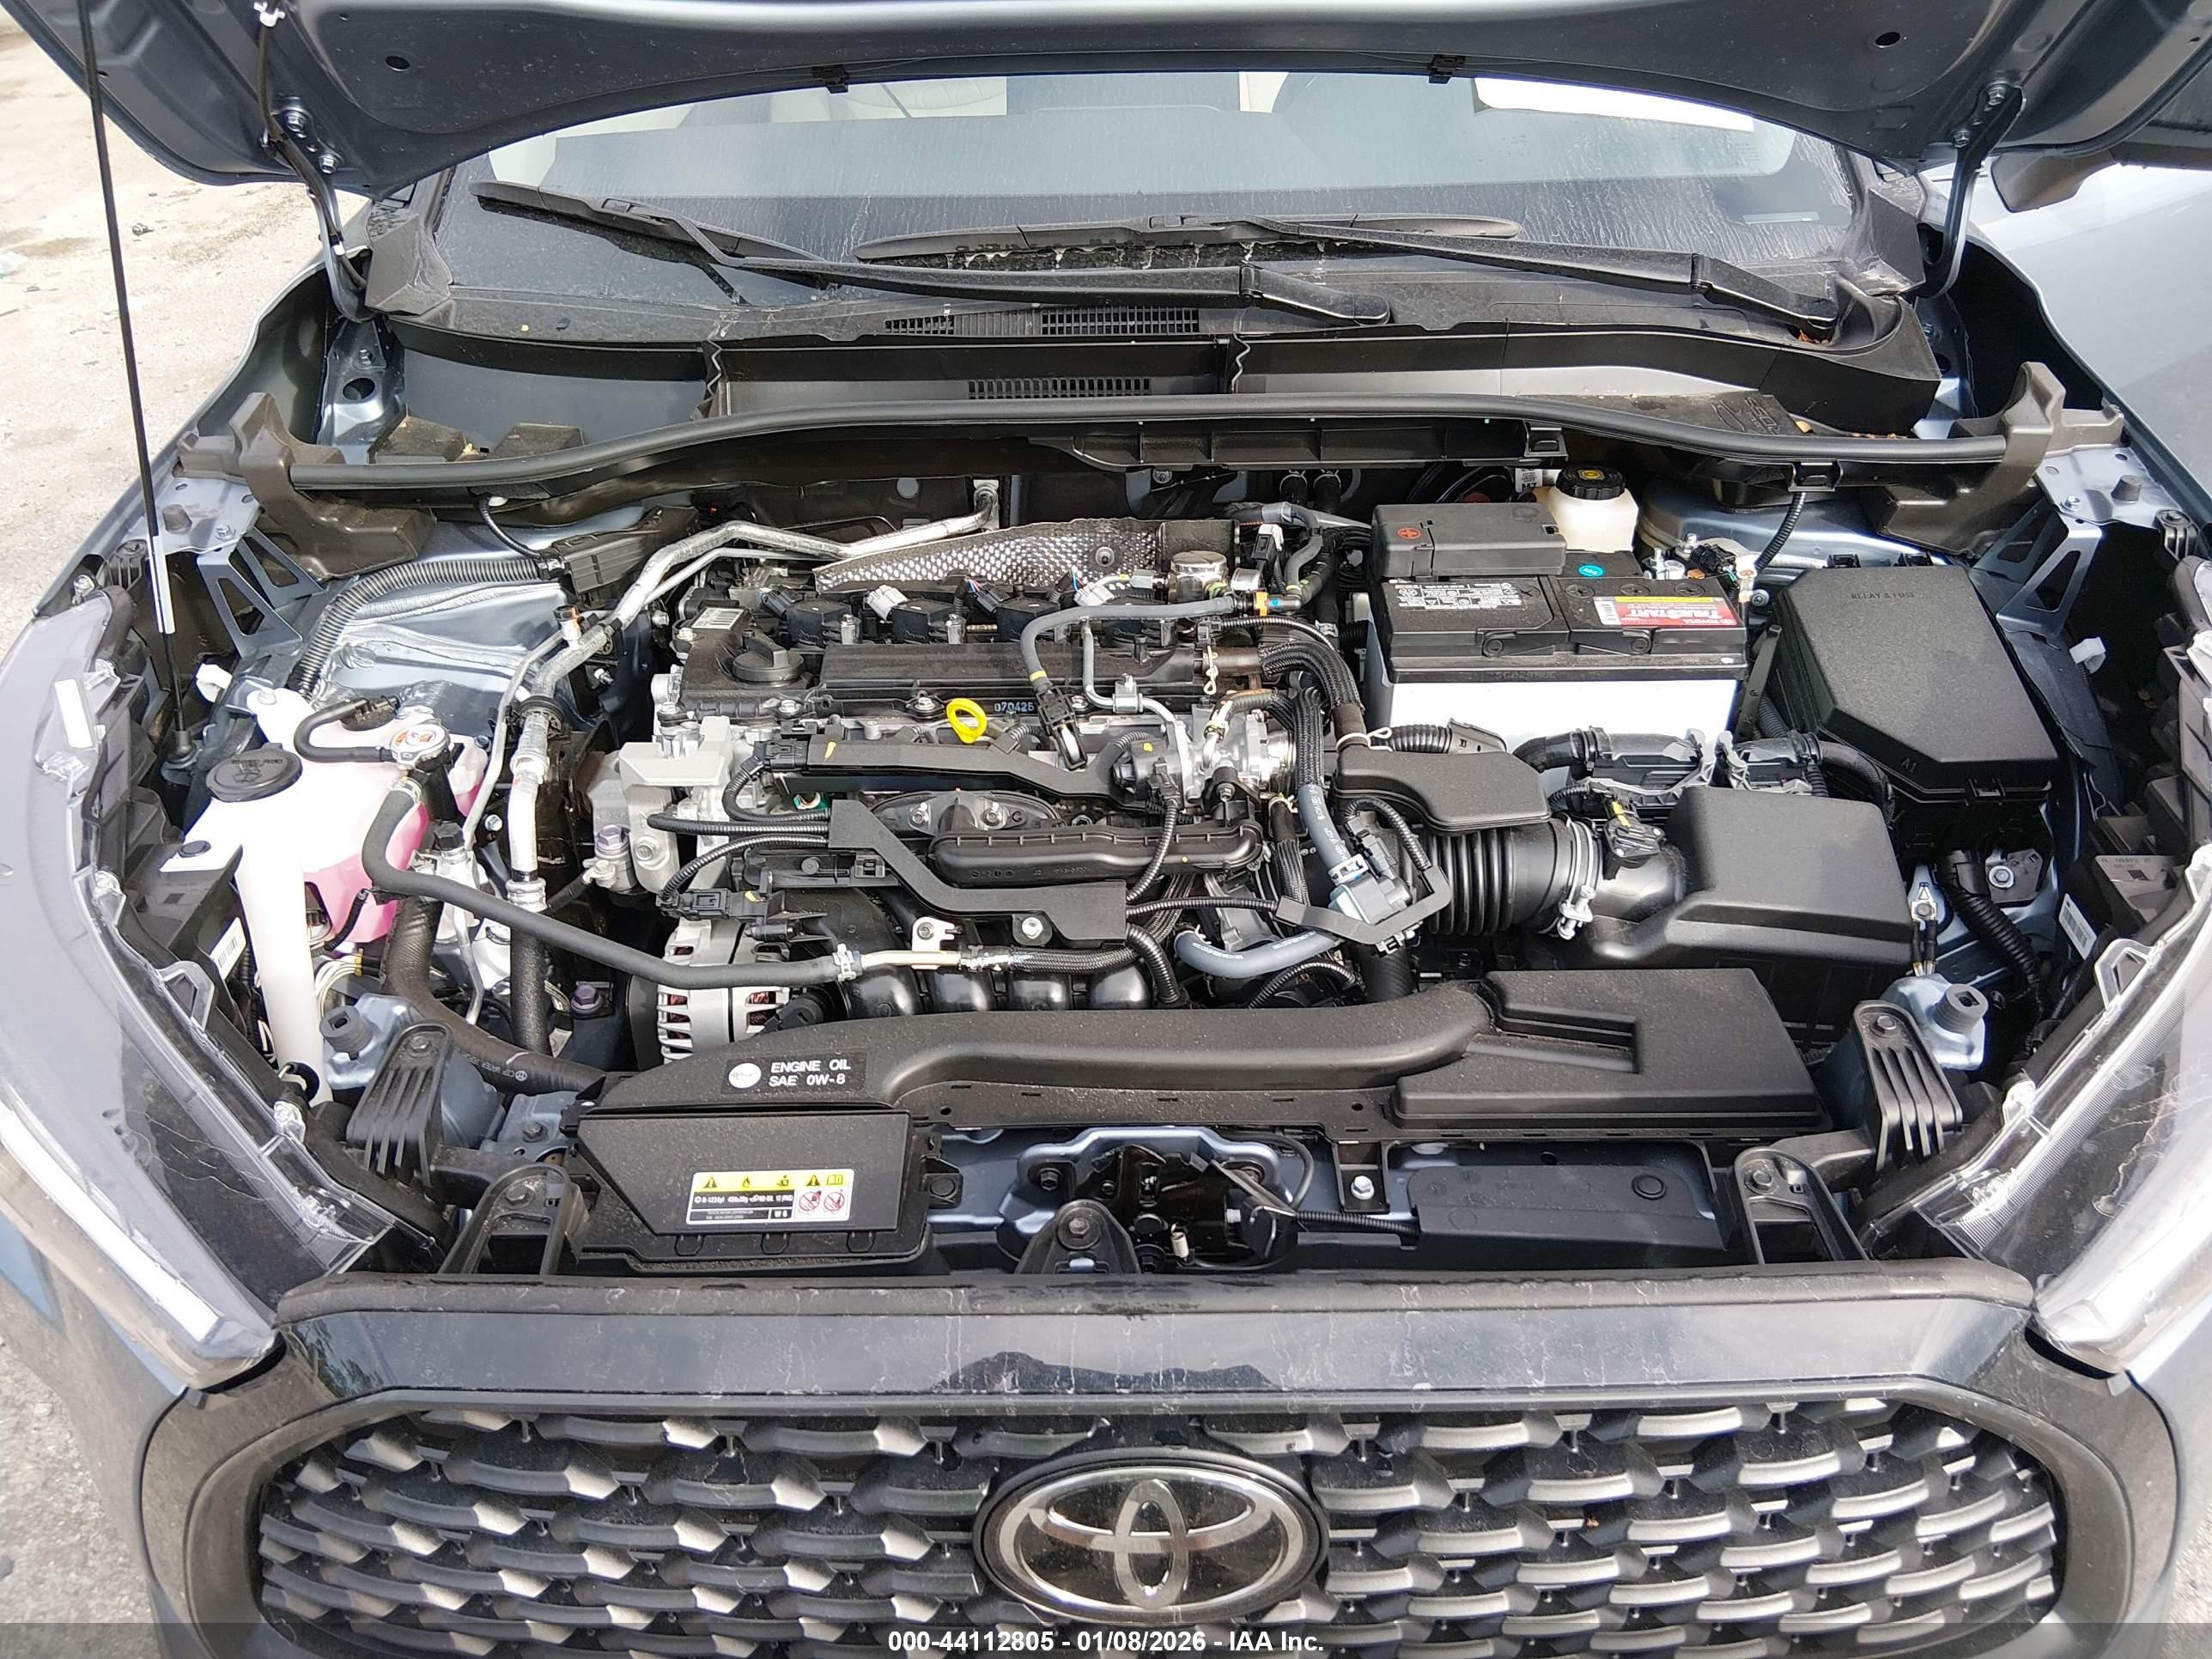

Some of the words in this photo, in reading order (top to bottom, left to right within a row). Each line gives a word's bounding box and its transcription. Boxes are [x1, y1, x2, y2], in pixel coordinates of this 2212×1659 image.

[770, 1060, 821, 1073] ENGINE
[829, 1059, 852, 1071] OIL
[769, 1075, 798, 1087] SAE
[806, 1073, 846, 1085] 0W-8
